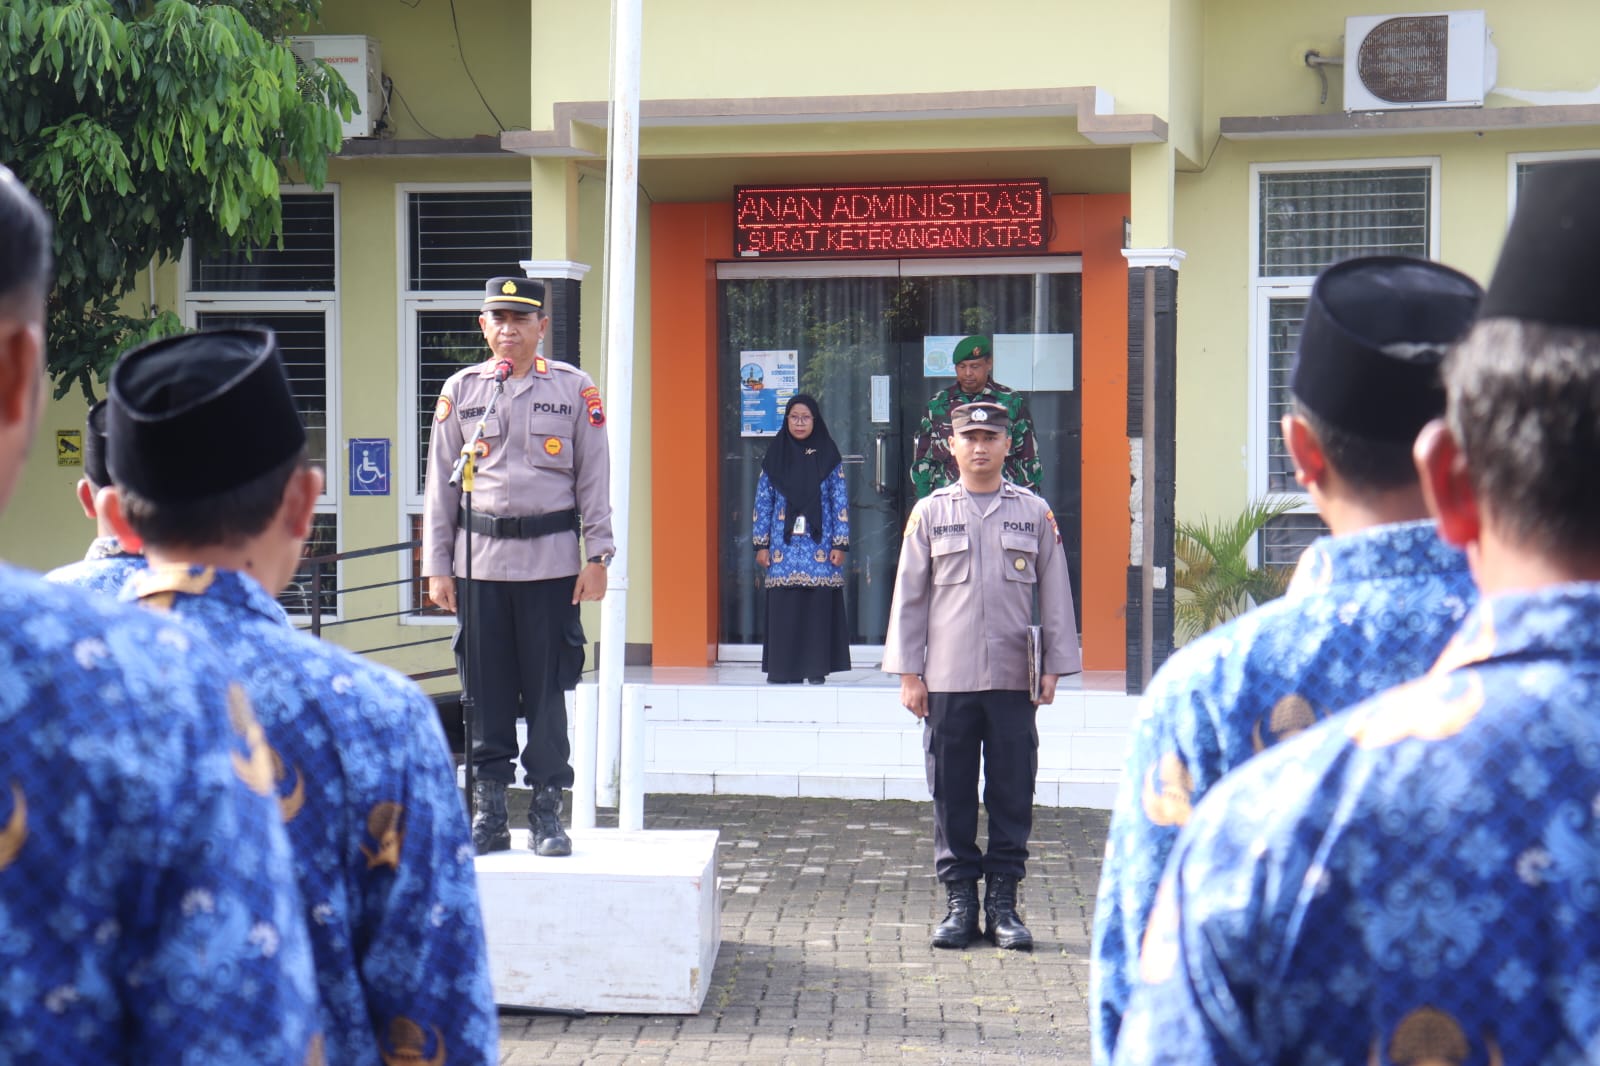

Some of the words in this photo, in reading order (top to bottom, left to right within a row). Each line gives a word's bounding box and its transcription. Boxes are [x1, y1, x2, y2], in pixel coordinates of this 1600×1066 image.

[739, 196, 821, 221] ANAN
[832, 189, 1041, 219] ADMINISTRASI
[749, 230, 819, 251] SURAT
[827, 226, 971, 250] KETERANGAN
[533, 402, 572, 415] POLRI
[933, 524, 967, 536] HENDRIK
[1003, 521, 1035, 533] POLRI
